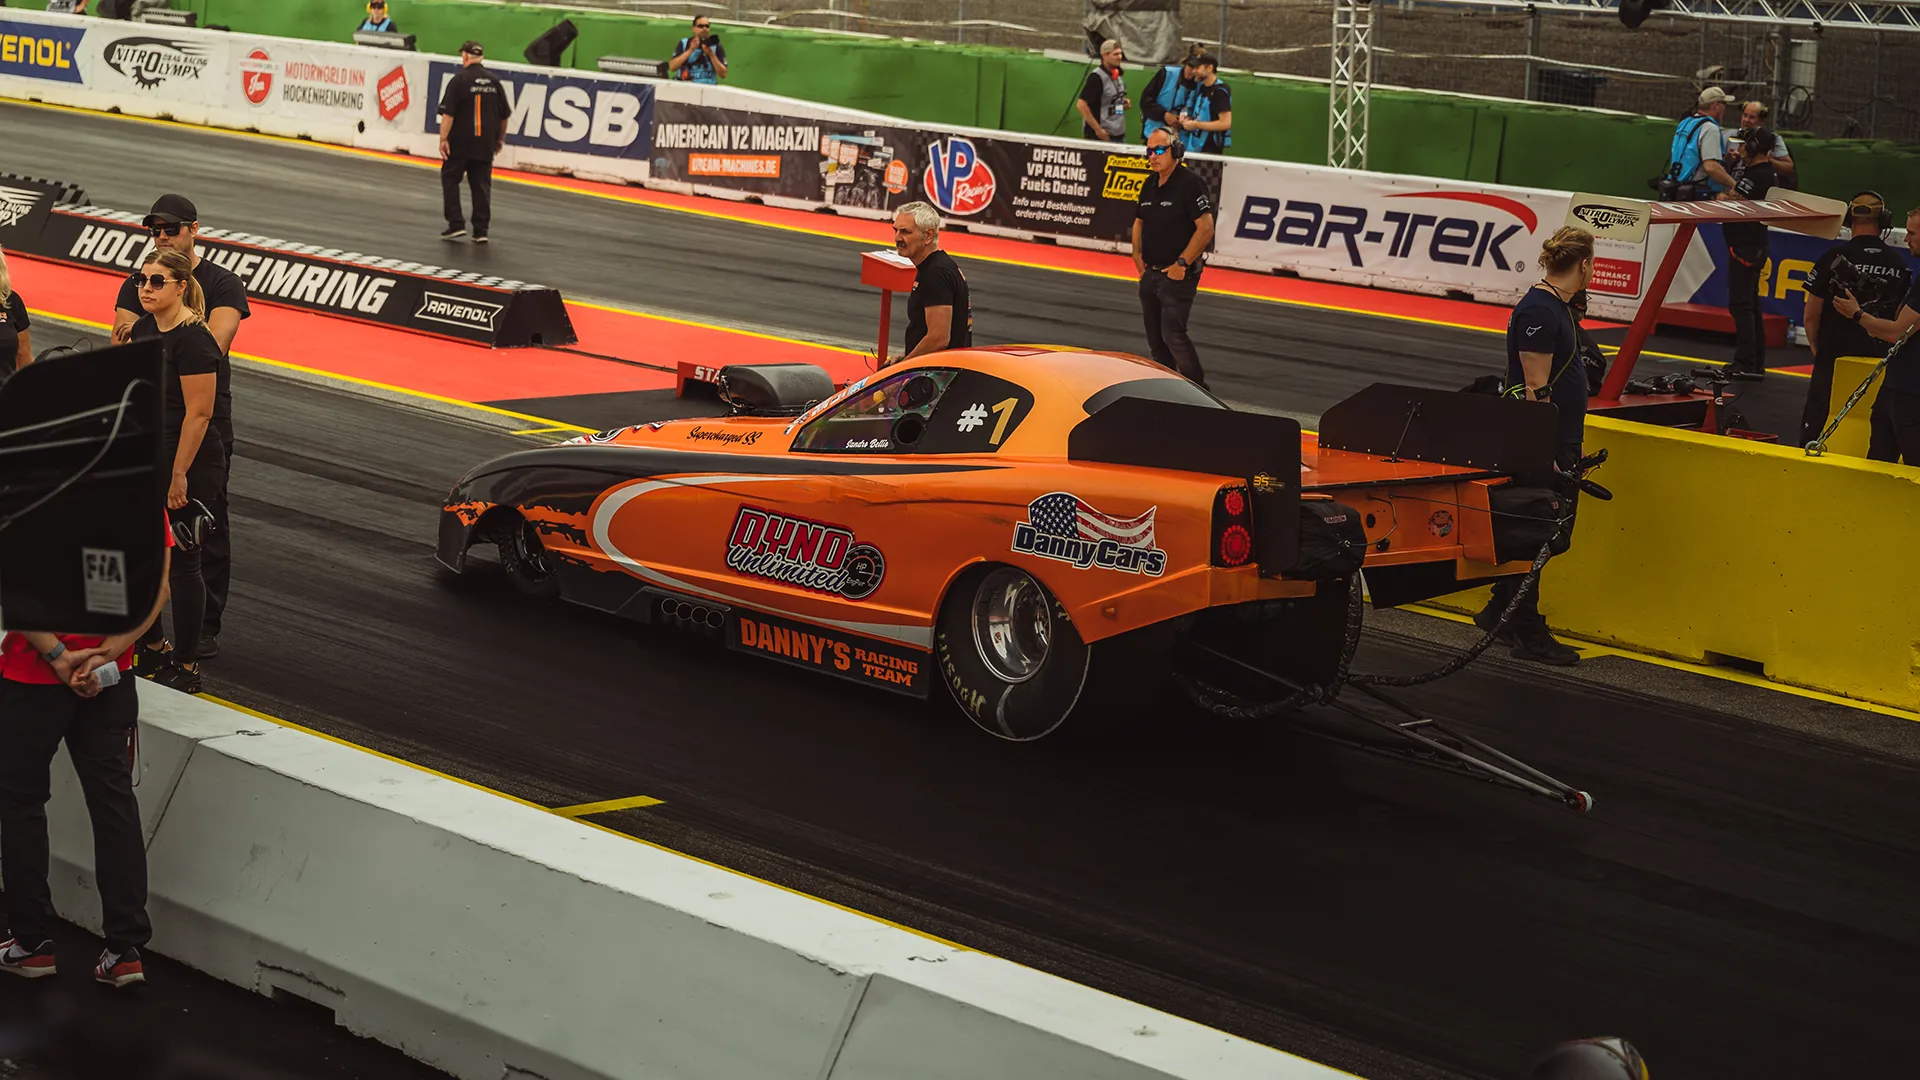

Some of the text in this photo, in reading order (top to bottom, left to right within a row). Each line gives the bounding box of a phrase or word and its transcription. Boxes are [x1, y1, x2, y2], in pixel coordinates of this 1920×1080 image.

[0, 33, 70, 69] ENOL
[284, 61, 366, 87] MOTORWORLD INN
[282, 83, 364, 110] HOCKENHEIMRING
[656, 123, 729, 149] AMERICAN
[731, 125, 750, 150] V2
[751, 125, 820, 151] MAGAZIN
[691, 157, 777, 175] DREAM-MACHINES.DE
[1033, 148, 1083, 166] OFFICIAL
[928, 137, 977, 209] VP
[1027, 163, 1087, 182] VP RACING
[1104, 165, 1150, 192] TRac
[1020, 176, 1091, 197] Fuels Dealer
[1012, 196, 1096, 215] Info und Bestellungen
[1015, 208, 1091, 225] order@ttr-shop.com
[69, 224, 397, 314] HOCHEIMRING
[1854, 264, 1901, 279] FFICIAL
[1590, 277, 1628, 288] TRIBUTOR
[427, 300, 489, 323] RAVENOL
[694, 366, 722, 384] STA
[957, 397, 1018, 445] #1
[686, 426, 744, 446] Supercharged
[729, 508, 853, 571] DYNO
[727, 544, 849, 592] Unlimited
[740, 618, 918, 674] DANNY'S RACING
[863, 663, 913, 687] TEAM
